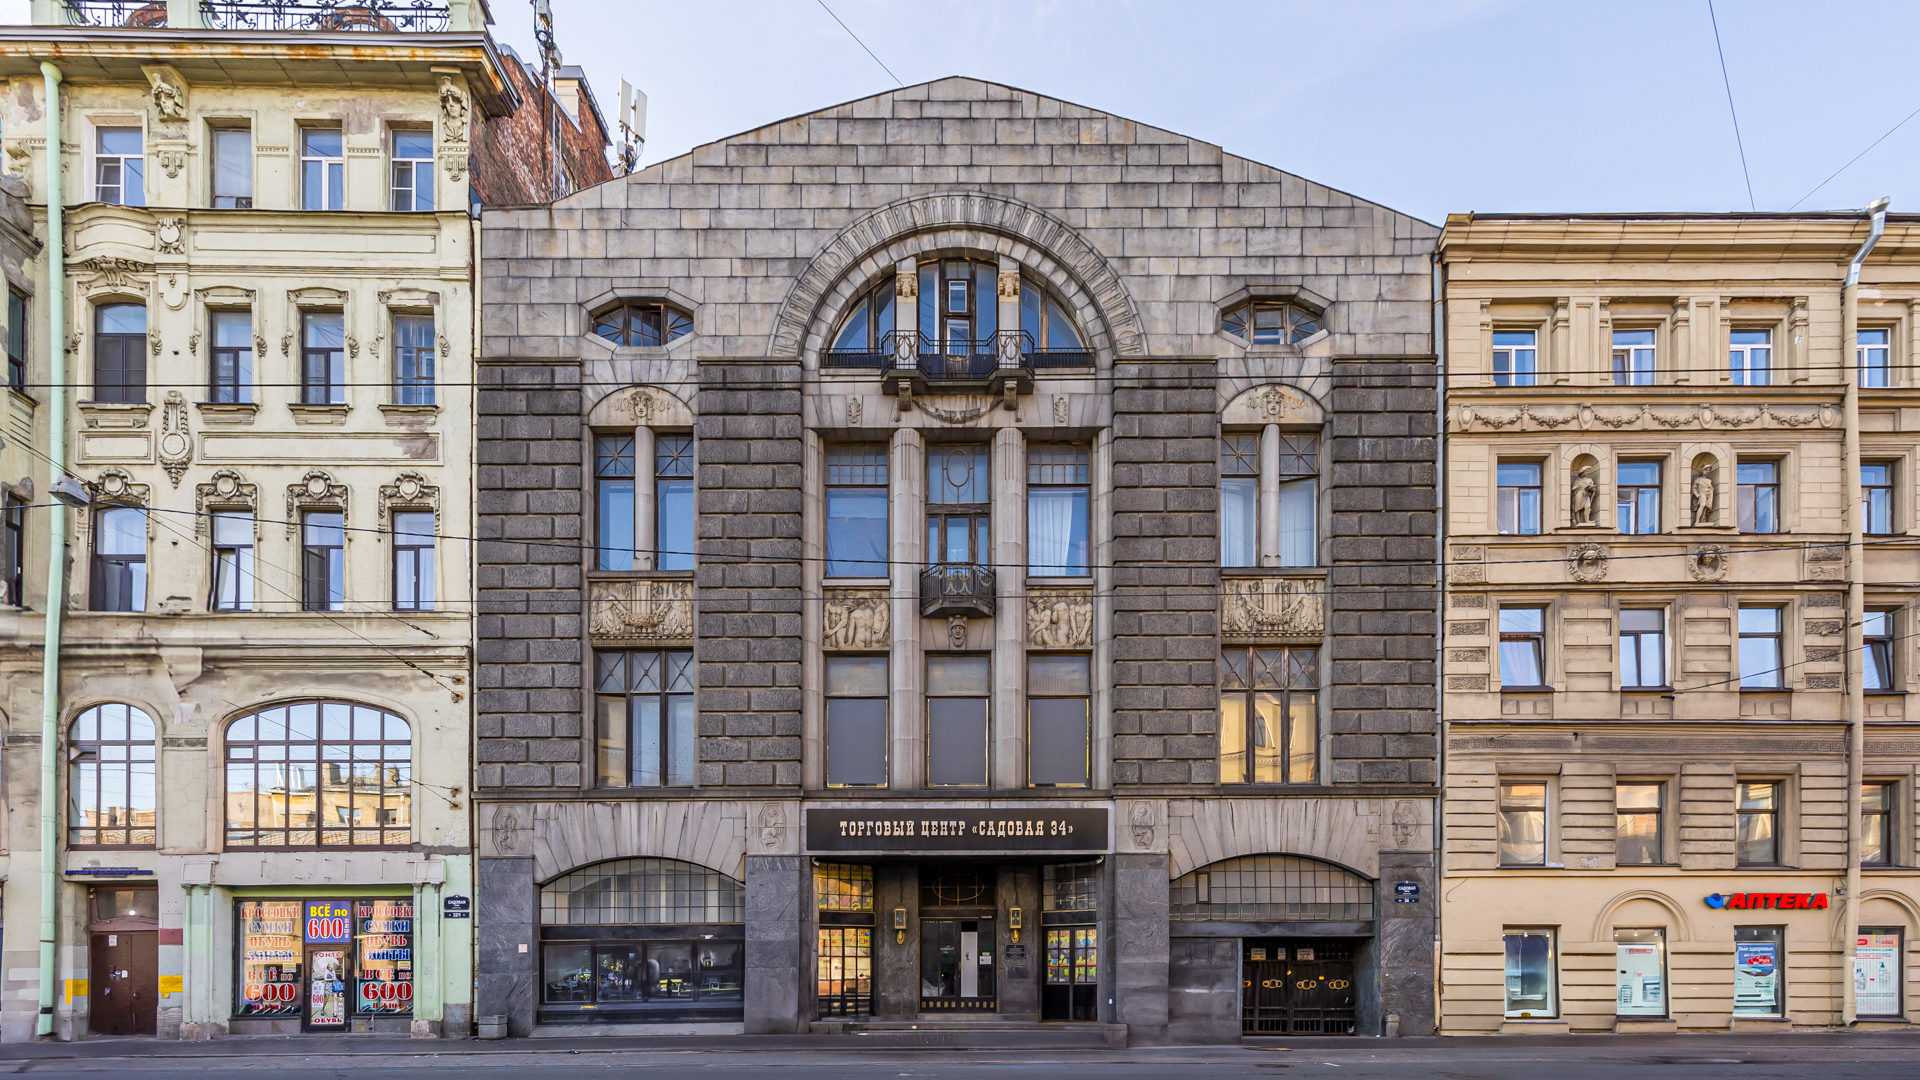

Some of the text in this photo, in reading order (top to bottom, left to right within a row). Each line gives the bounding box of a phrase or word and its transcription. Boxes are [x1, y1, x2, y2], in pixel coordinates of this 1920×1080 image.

[839, 820, 1074, 838] ТОРГОВЫЙ ЦЕНТР «САДОВАЯ 34»
[1728, 893, 1828, 909] АПТЕКА
[240, 906, 301, 919] КРОССОВКИ
[310, 903, 331, 917] ВСЁ
[247, 921, 293, 933] СУМКИ
[307, 918, 344, 939] 600
[364, 920, 410, 933] СУМКИ
[249, 935, 291, 948] ОБУВЬ
[365, 934, 408, 947] ОБУВЬ
[247, 950, 294, 962] ЗОНТЫ
[364, 949, 411, 961] ЗОНТЫ
[247, 967, 277, 981] ВСЁ
[364, 965, 395, 979] ВСЁ
[245, 983, 295, 1002] 600
[362, 981, 413, 1001] 600
[312, 994, 323, 1003] 600
